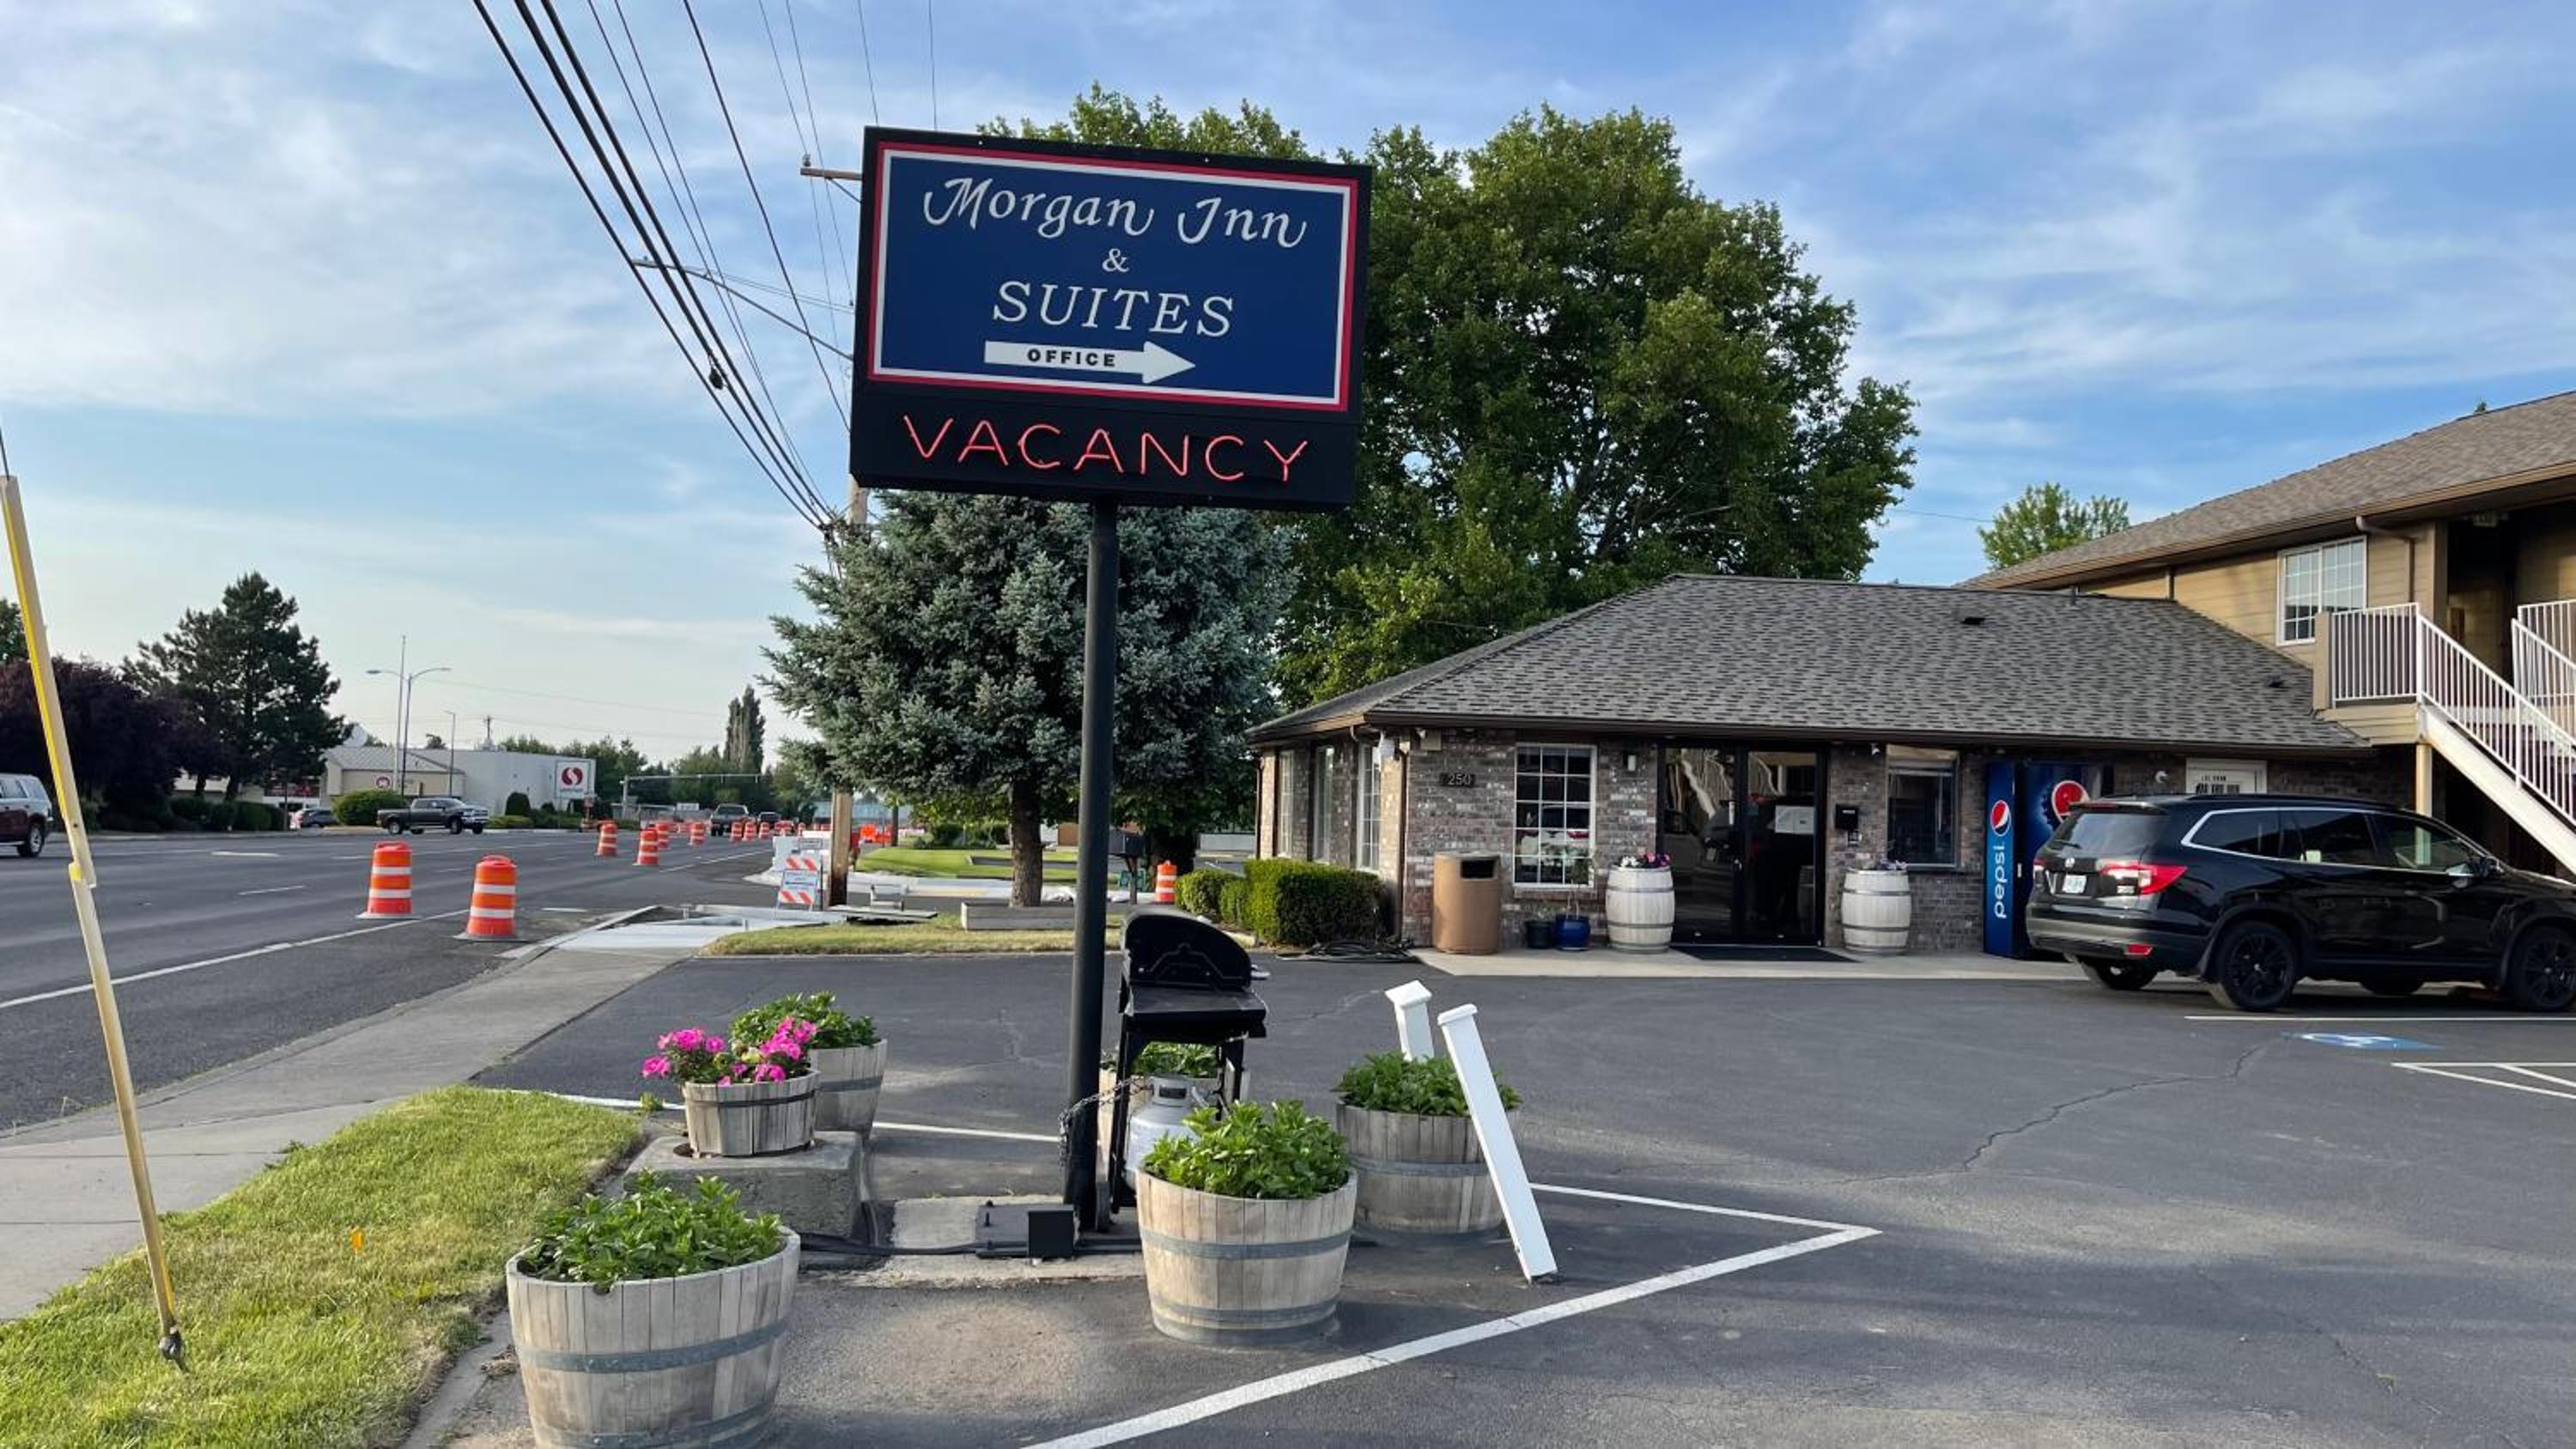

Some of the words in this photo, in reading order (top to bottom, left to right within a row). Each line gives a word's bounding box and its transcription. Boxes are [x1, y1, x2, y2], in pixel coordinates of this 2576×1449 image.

[923, 178, 1154, 239] Morgan
[1177, 197, 1307, 248] Inn
[1102, 247, 1129, 273] &
[993, 281, 1234, 338] SUITES
[1027, 349, 1115, 367] OFFICE
[903, 415, 1308, 482] VACANCY
[1993, 845, 2008, 919] pepsi
